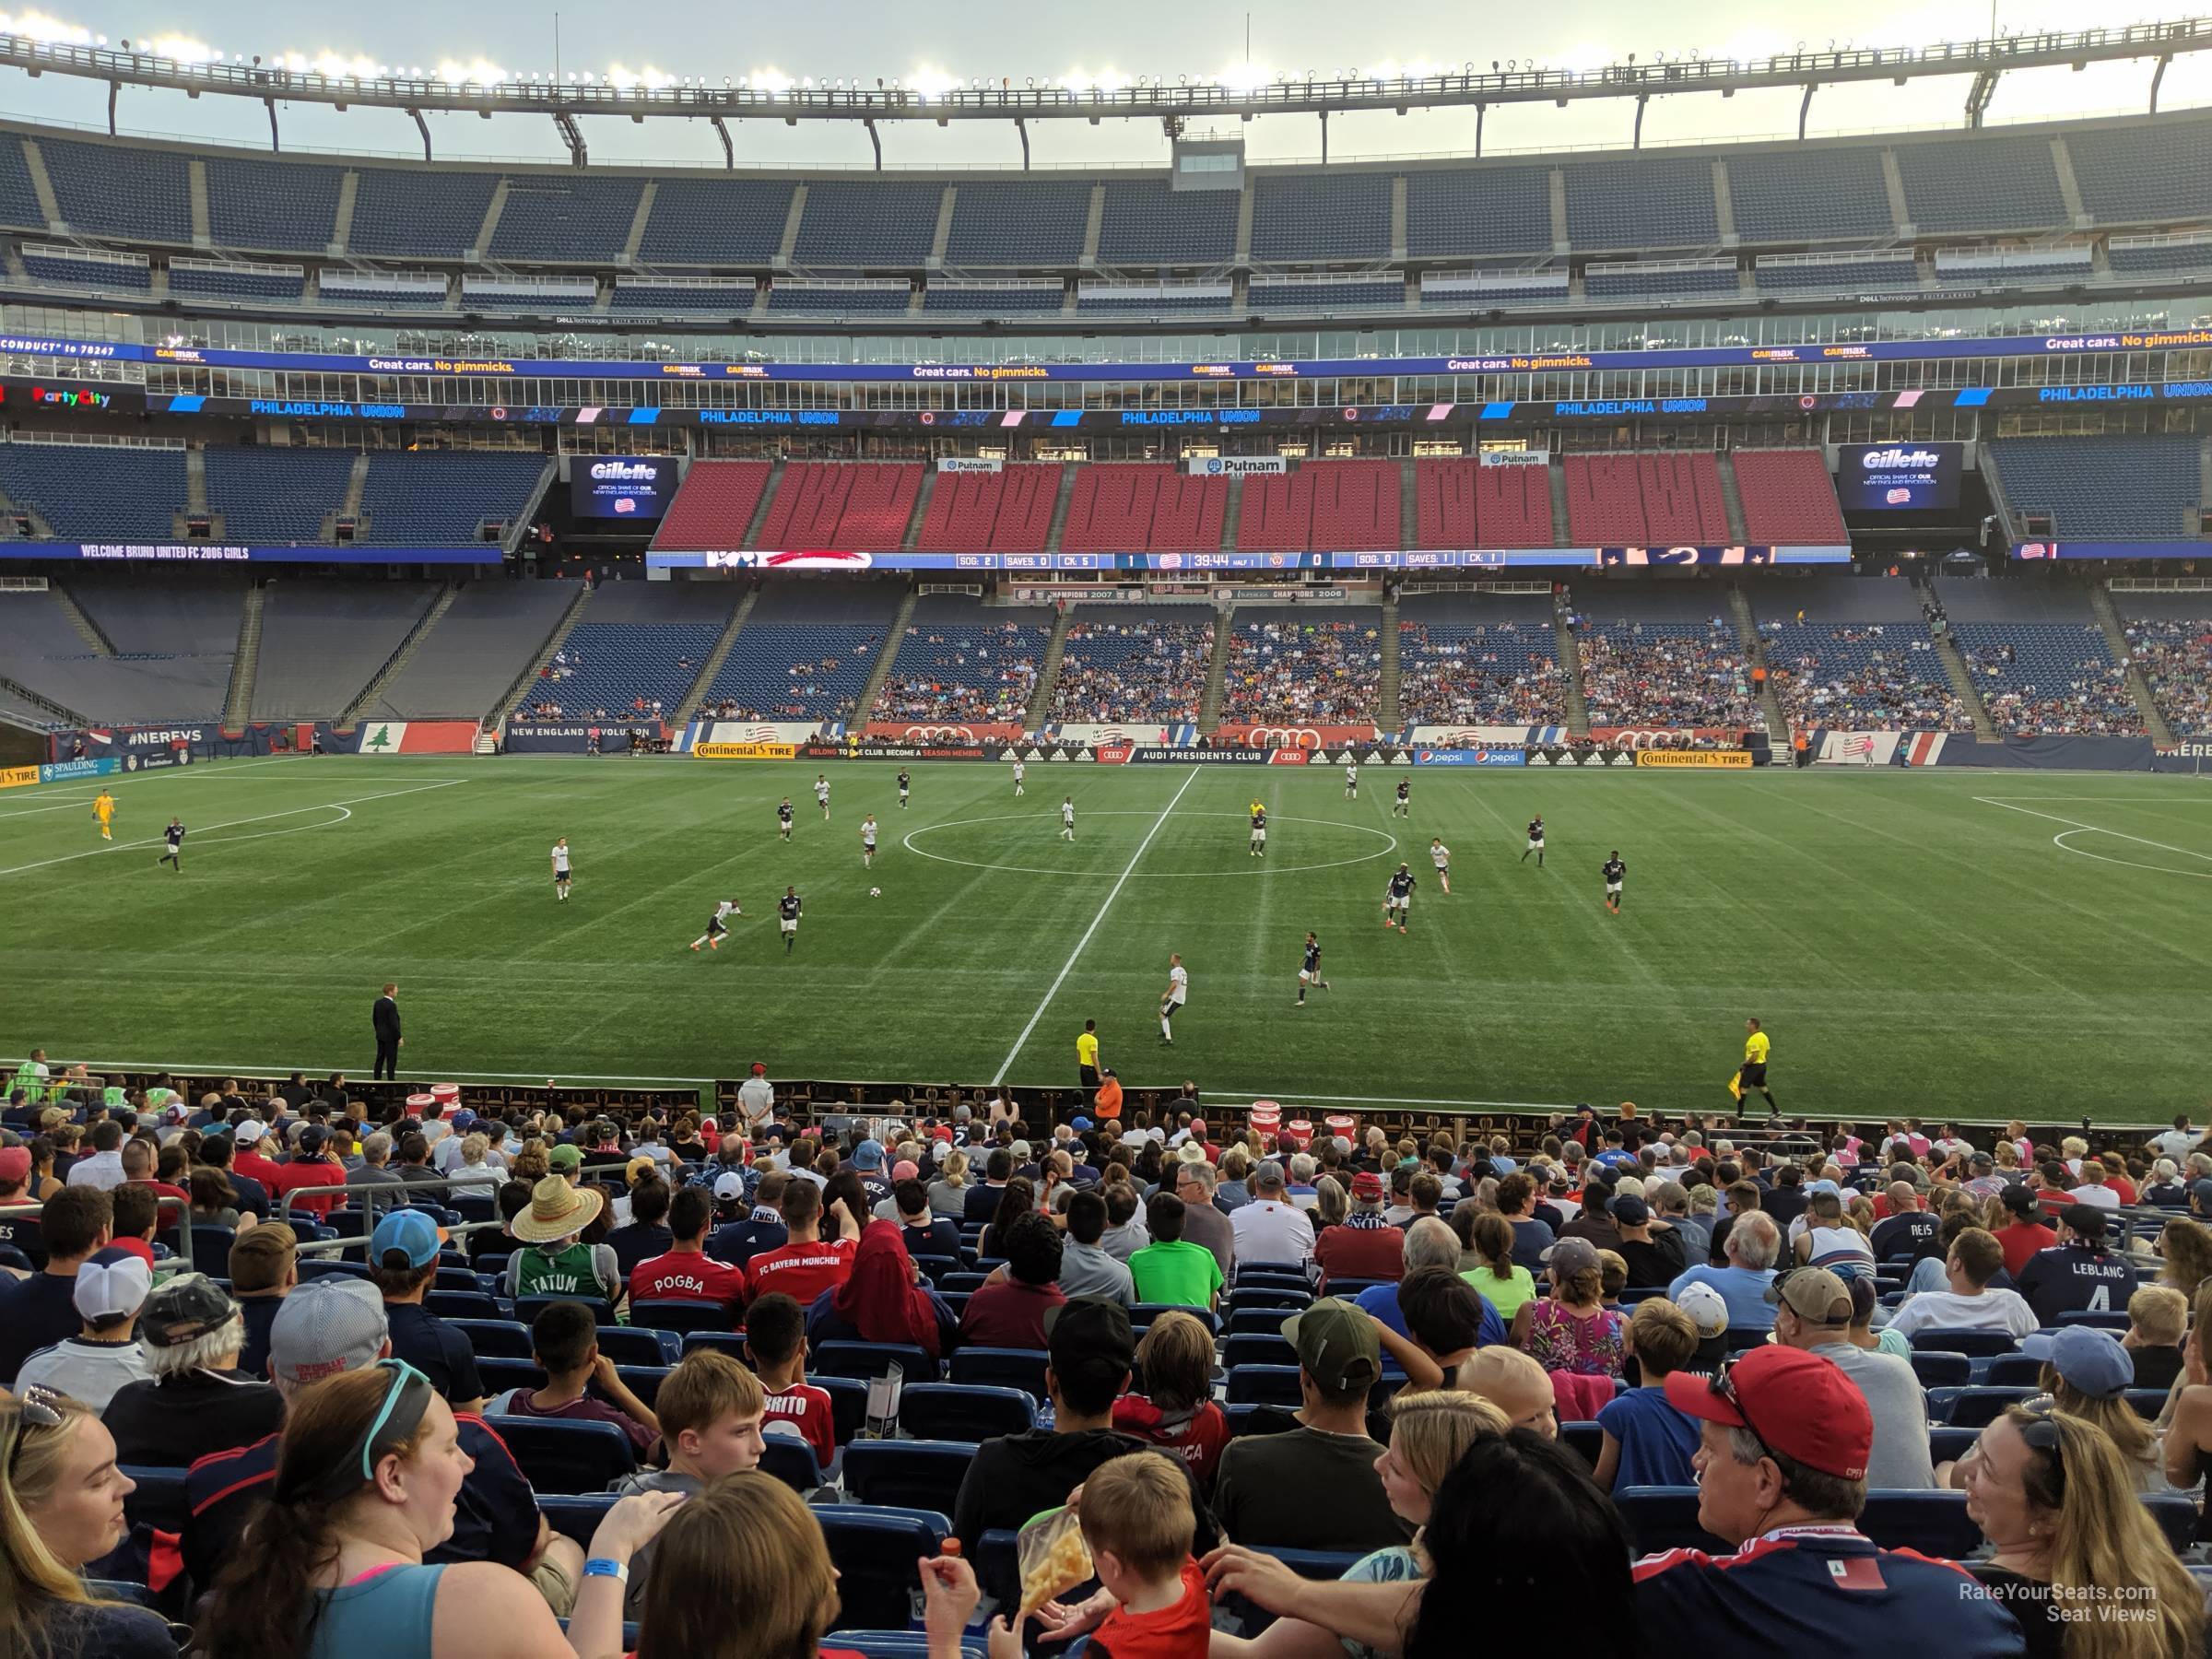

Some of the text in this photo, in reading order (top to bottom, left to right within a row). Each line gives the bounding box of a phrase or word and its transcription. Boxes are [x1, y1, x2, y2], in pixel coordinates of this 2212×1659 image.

[2046, 337, 2084, 349] Great
[2087, 336, 2119, 347] cars.
[2122, 335, 2142, 347] No
[65, 345, 76, 354] to
[80, 346, 114, 357] 78247
[369, 359, 514, 372] Great cars. No gimmicks.
[1448, 356, 1593, 370] Great cars. No gimmicks.
[913, 367, 1049, 379] Great cars. No gimmicks.
[2040, 385, 2154, 401] PHILADELPHIA
[251, 401, 404, 418] PHILADELPHIA UNION
[1556, 399, 1706, 416] PHILADELPHIA UNION
[700, 411, 839, 424] PHILADELPHIA UNION
[1122, 410, 1260, 425] PHILADELPHIA UNION
[1864, 449, 1937, 468] Gillette
[591, 462, 655, 480] Gillette
[1225, 460, 1279, 472] Putnam
[81, 545, 249, 559] WELCOME BRUNO UNITED FC 2006 GIRLS
[1408, 554, 1448, 563] SAVES: 1
[1470, 554, 1495, 562] CK: 1
[960, 557, 991, 565] SOG: 2
[1007, 557, 1035, 565] SAVES:
[1065, 557, 1088, 565] CK: 5
[1128, 556, 1134, 567] 1
[1194, 555, 1229, 566] 39:44
[1312, 554, 1322, 566] 0
[1359, 554, 1392, 564] SOG: 0
[512, 728, 650, 736] NEW ENGLAND VOLUON
[698, 744, 793, 757] Continental TIRE
[1142, 751, 1262, 760] AUDI PRESIDENTS CLUB
[1435, 752, 1463, 762] pepsi
[1490, 752, 1519, 762] pepsi
[1641, 751, 1747, 766] Continental TIRE
[54, 759, 98, 772] SPAULDING
[15, 771, 37, 782] TIRE
[1911, 1224, 1933, 1236] REIS
[759, 1265, 769, 1277] FC
[770, 1258, 800, 1271] BAYERN
[2073, 1263, 2124, 1278] LEBLANC
[530, 1274, 578, 1295] TATUM
[654, 1275, 703, 1294] POGBA
[2087, 1285, 2110, 1312] 4
[764, 1395, 806, 1416] BRITO
